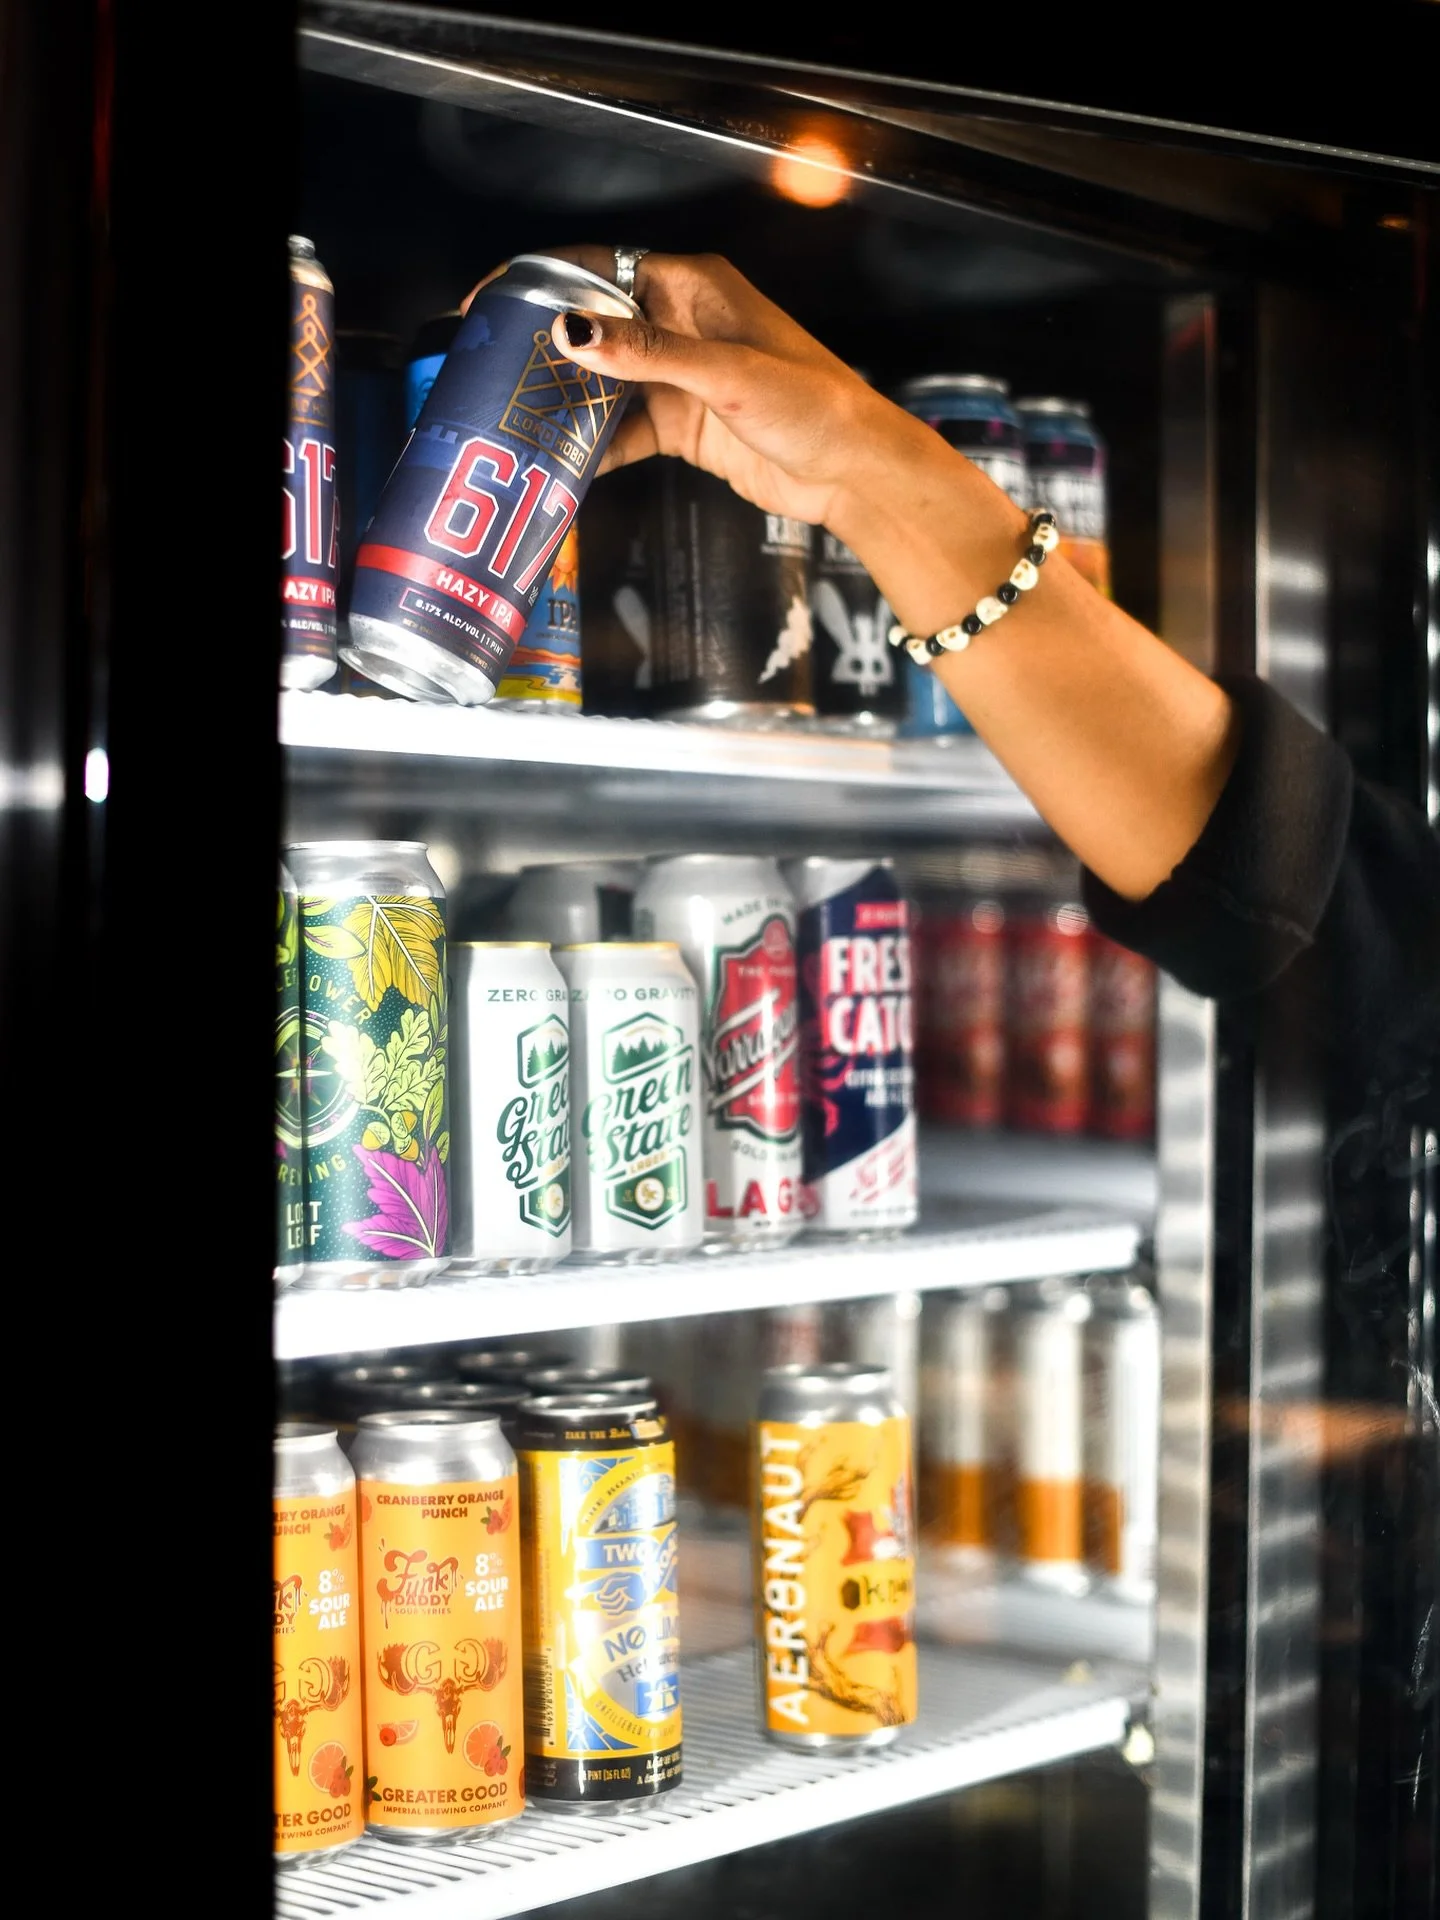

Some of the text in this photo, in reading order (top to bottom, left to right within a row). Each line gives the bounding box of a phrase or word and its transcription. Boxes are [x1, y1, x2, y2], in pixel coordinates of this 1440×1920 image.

[513, 412, 584, 466] LORD HOBO
[424, 437, 579, 593] 617
[284, 581, 317, 601] AZY
[436, 570, 490, 607] HAZY
[490, 600, 513, 627] IPA
[443, 612, 480, 639] ALC/VOL
[490, 641, 504, 656] PINT
[488, 988, 538, 1002] ZERO
[581, 1058, 692, 1158] Green
[590, 1102, 692, 1180] State
[376, 1490, 504, 1506] CRANBERRY ORANGE
[300, 1504, 346, 1521] ORANGE
[422, 1507, 468, 1519] PUNCH
[275, 1523, 311, 1537] UNCH
[377, 1550, 459, 1601] Funk
[465, 1576, 509, 1597] SOUR
[760, 1427, 808, 1725] AERONAUT
[309, 1593, 350, 1615] SOUR
[394, 1594, 451, 1606] DADDY
[475, 1594, 505, 1613] ALE
[318, 1609, 346, 1631] ALE
[595, 1700, 643, 1736] UNFILTERED
[382, 1781, 508, 1804] GREATER GOOD
[307, 1802, 352, 1825] GOOD
[383, 1799, 507, 1816] IMPERIAL BREWING COMPANY
